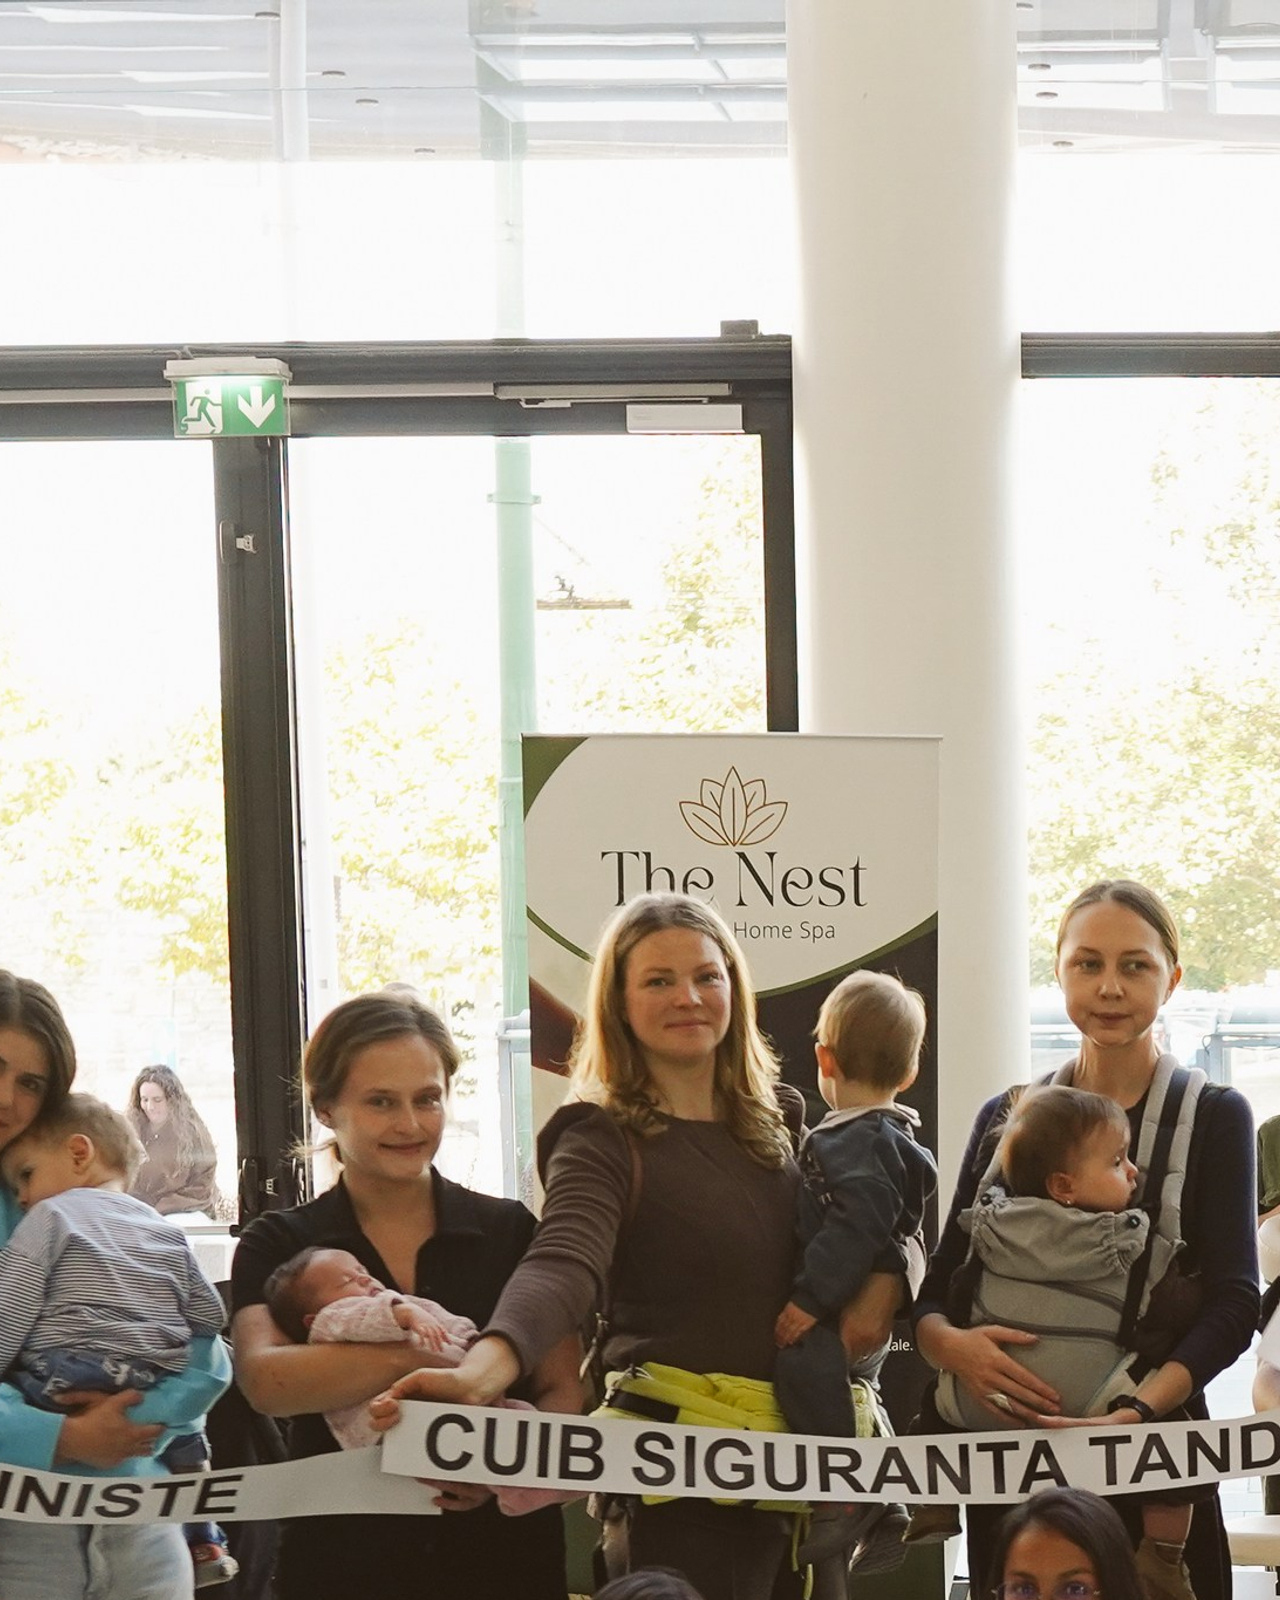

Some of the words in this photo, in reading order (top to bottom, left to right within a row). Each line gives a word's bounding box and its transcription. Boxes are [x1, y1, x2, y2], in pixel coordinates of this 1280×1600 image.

[601, 851, 715, 906] The
[735, 851, 868, 907] Nest
[733, 922, 792, 939] Home
[800, 921, 836, 943] Spa
[425, 1413, 605, 1481] CUIB
[631, 1431, 1068, 1495] SIGURANTA
